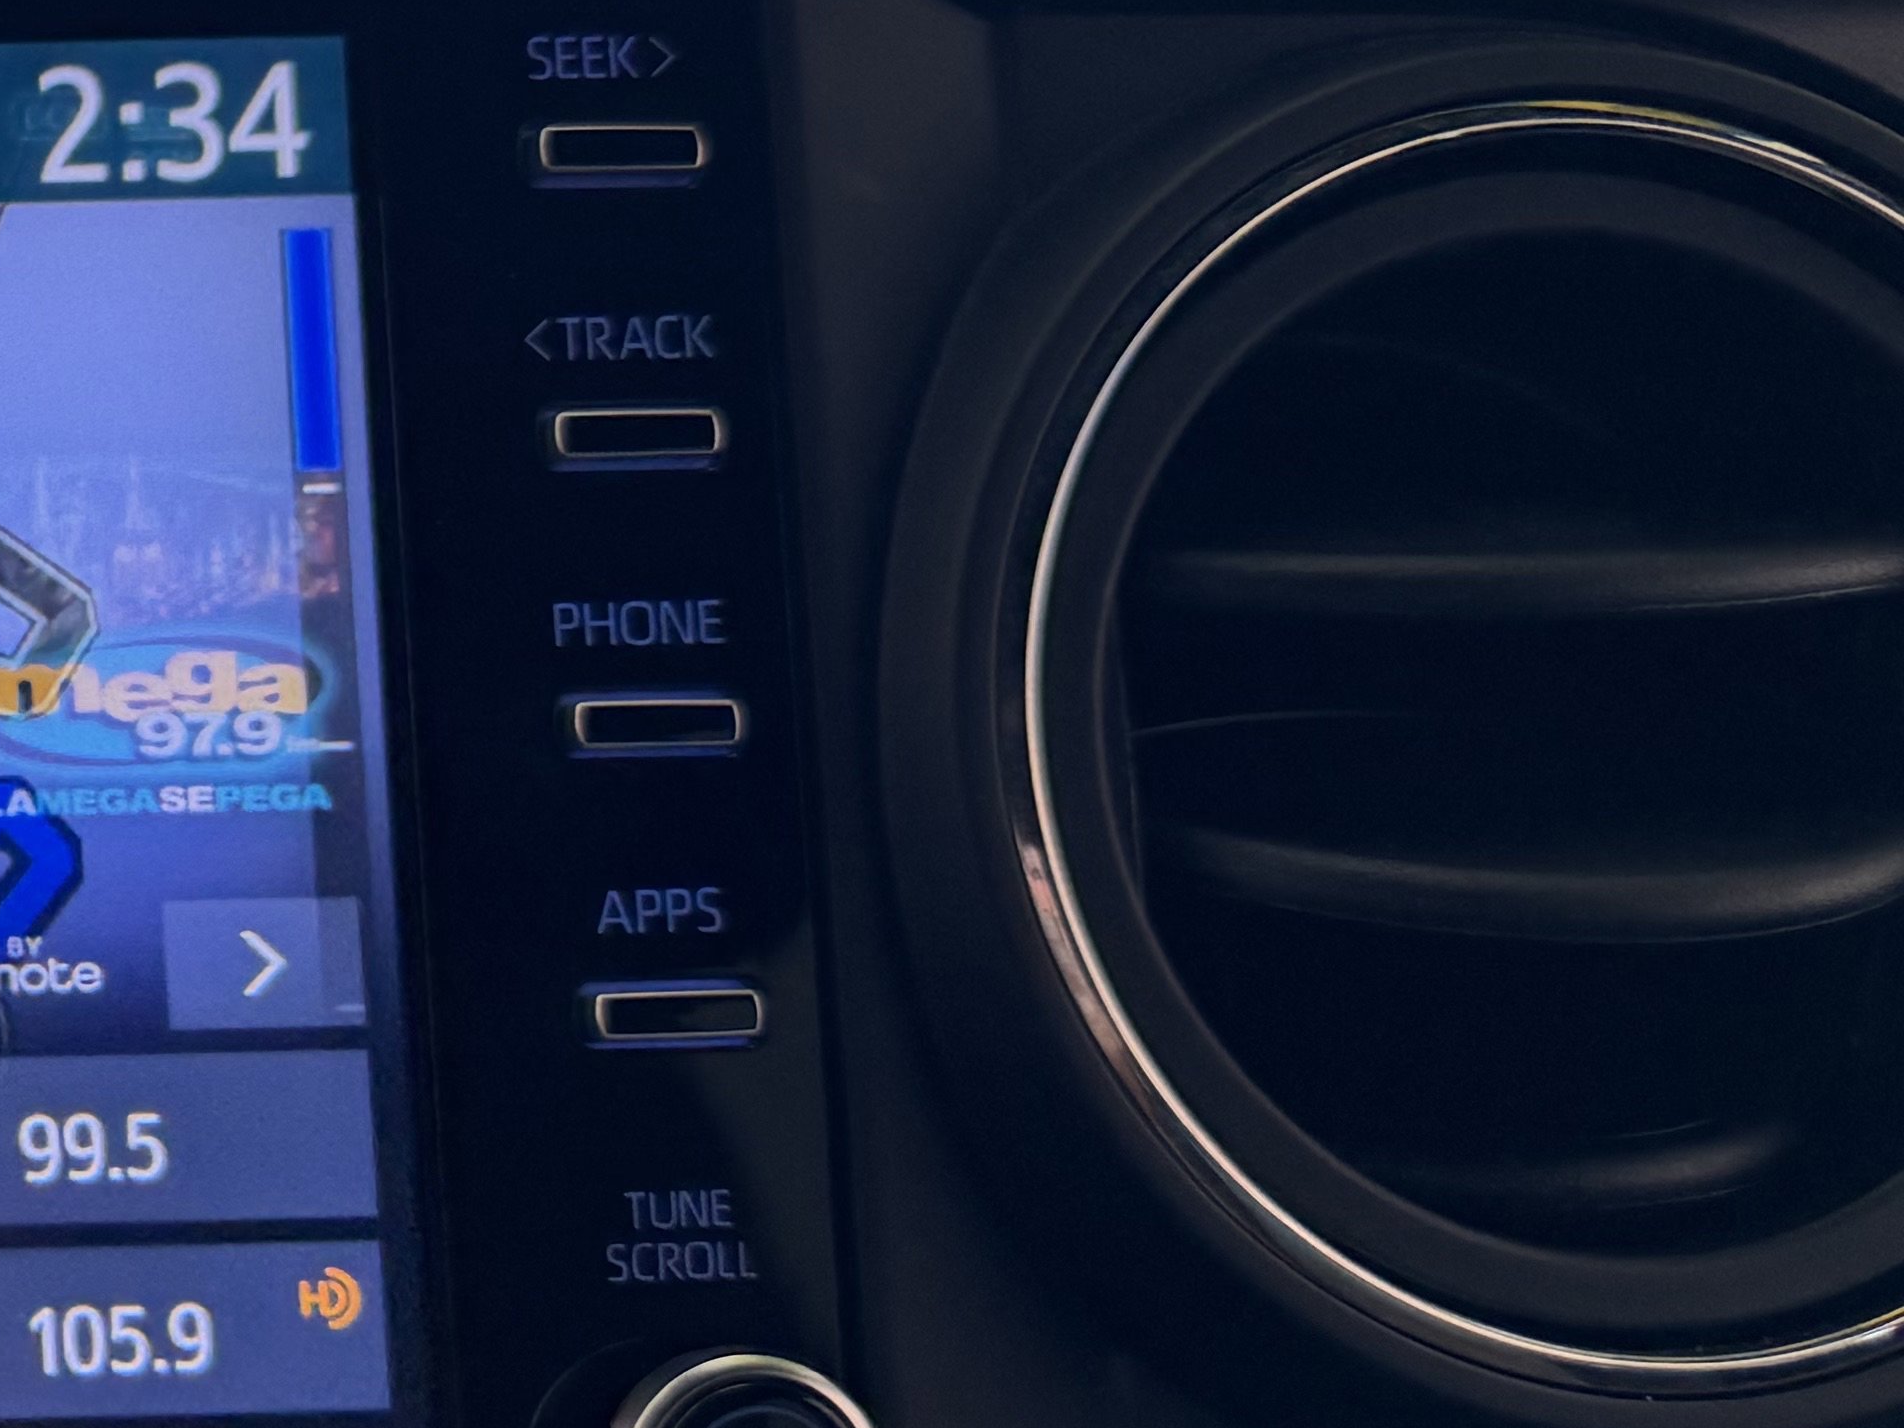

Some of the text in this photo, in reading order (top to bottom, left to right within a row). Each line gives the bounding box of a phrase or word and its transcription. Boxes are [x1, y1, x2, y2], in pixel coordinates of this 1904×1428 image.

[37, 59, 313, 184] 2:34
[552, 599, 727, 647] PHONE
[135, 710, 282, 759] 97.9
[597, 887, 725, 934] APPS
[6, 935, 42, 958] BY
[17, 1111, 170, 1186] 99.5
[624, 1189, 734, 1230] TUNE
[606, 1240, 758, 1283] SCROLL
[28, 1301, 214, 1377] 105.9
